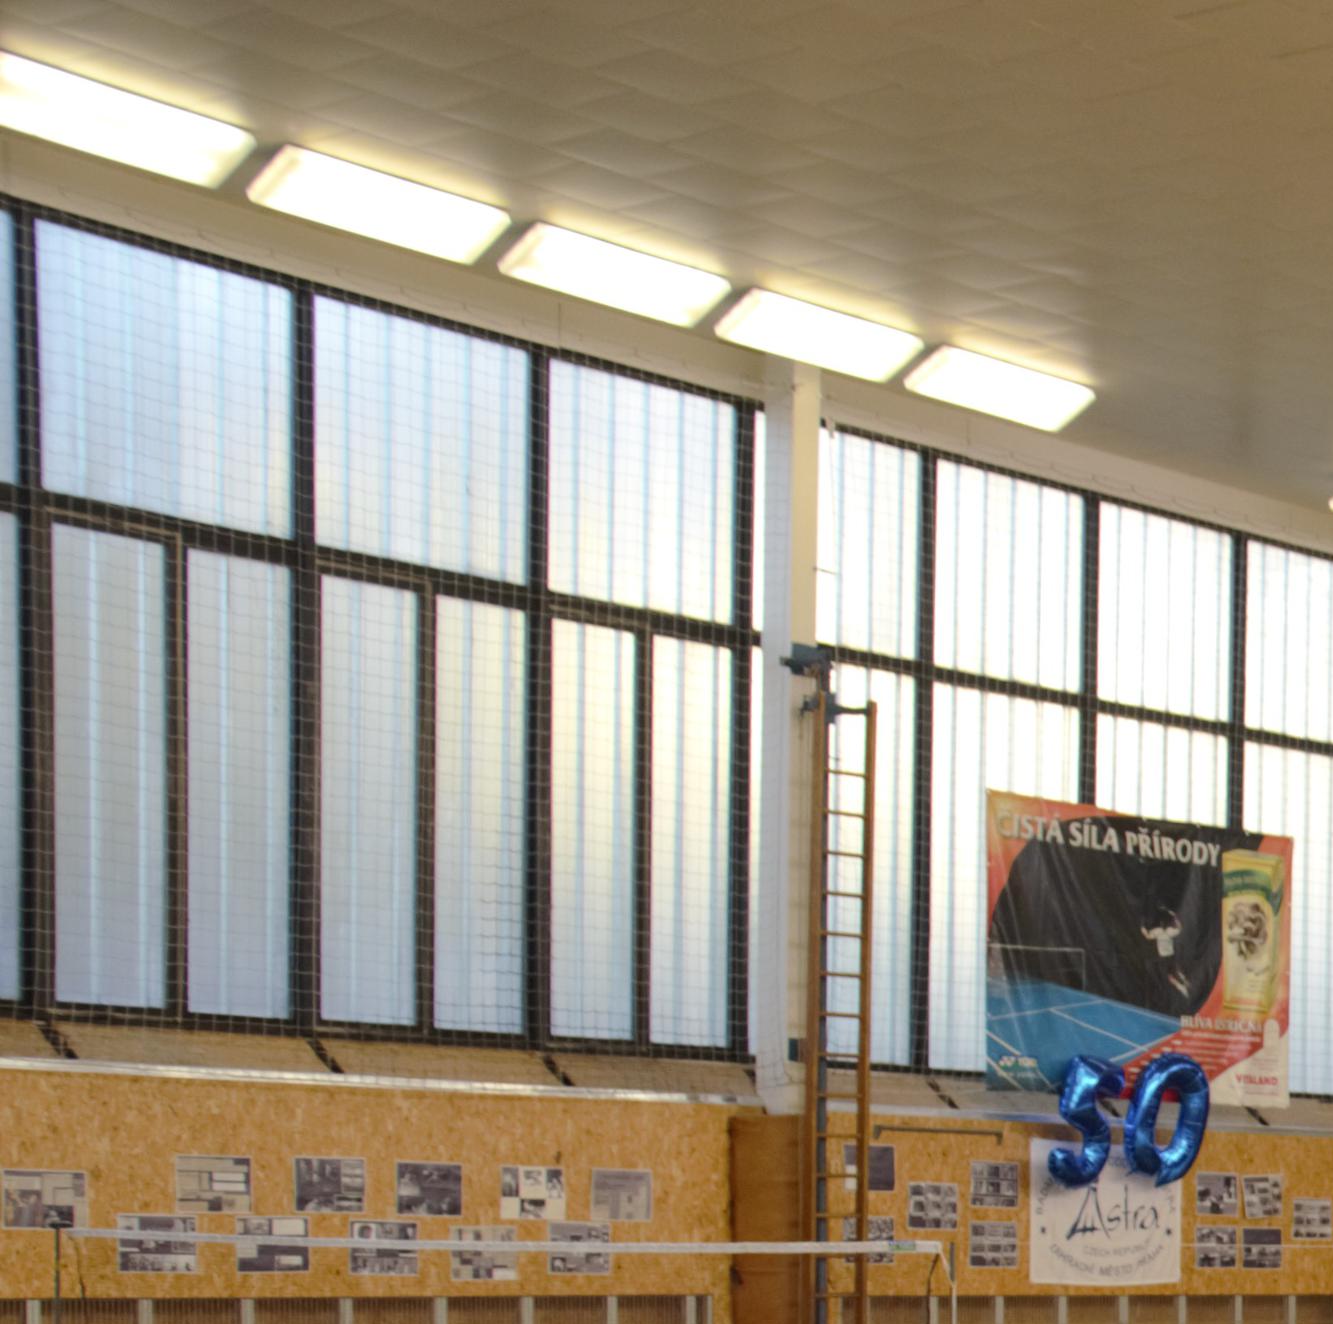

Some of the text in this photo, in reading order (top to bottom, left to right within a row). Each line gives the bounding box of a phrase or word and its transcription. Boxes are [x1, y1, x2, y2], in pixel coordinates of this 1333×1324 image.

[1068, 817, 1120, 854] SÍLA
[1125, 827, 1221, 868] PŘÍRODY
[1047, 1054, 1210, 1188] 50
[1065, 1183, 1161, 1242] Astra
